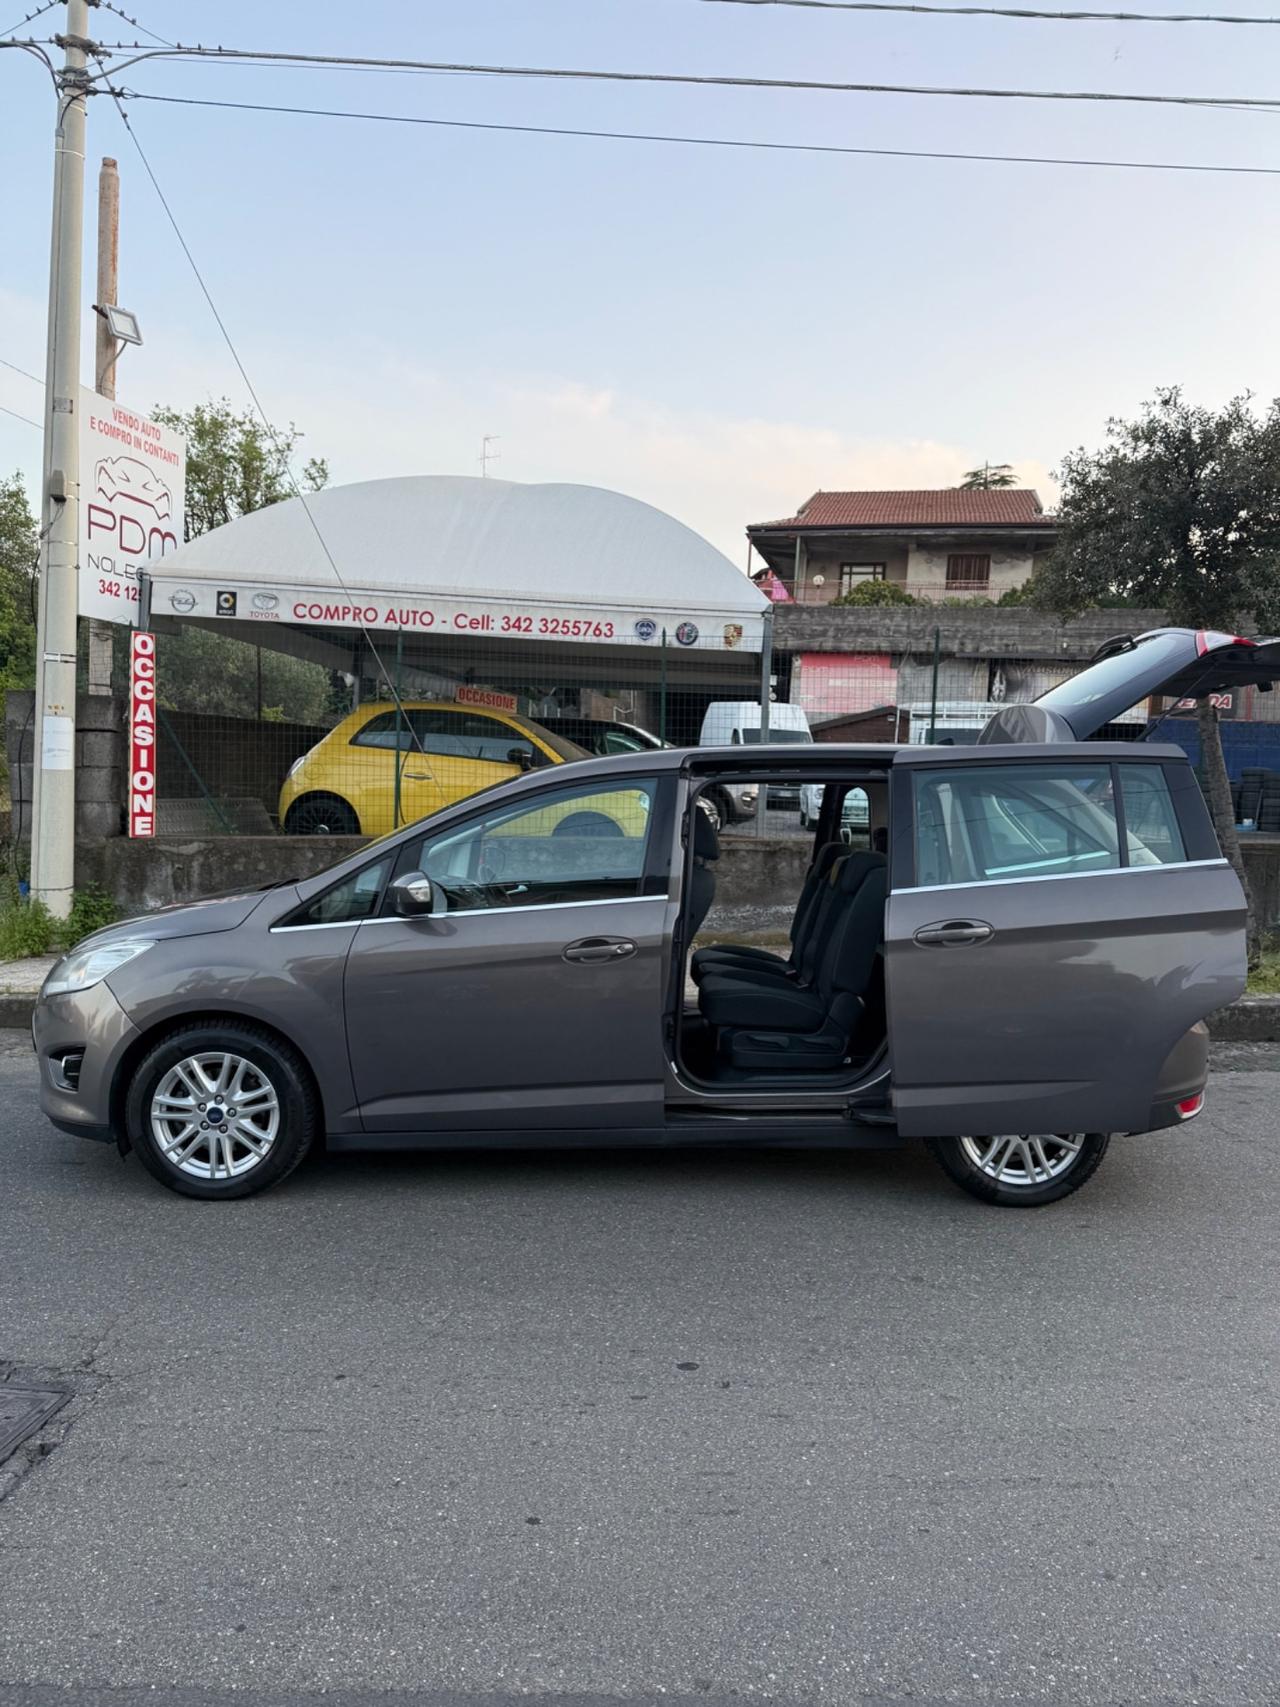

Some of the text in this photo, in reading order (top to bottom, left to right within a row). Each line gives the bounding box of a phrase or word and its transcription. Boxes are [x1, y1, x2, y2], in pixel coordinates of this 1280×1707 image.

[90, 415, 179, 467] E COMPRO IN CONTANTI
[112, 407, 161, 441] VENDO AUTO
[98, 579, 121, 598] 342
[250, 611, 280, 619] TOYOTA
[293, 603, 378, 623] COMPRO
[384, 608, 435, 627] AUTO
[454, 612, 495, 631] Cell:
[501, 615, 533, 633] 342
[538, 617, 615, 639] 3255763
[458, 687, 515, 710] OCCASIONE
[133, 634, 155, 836] OCCASIONE
